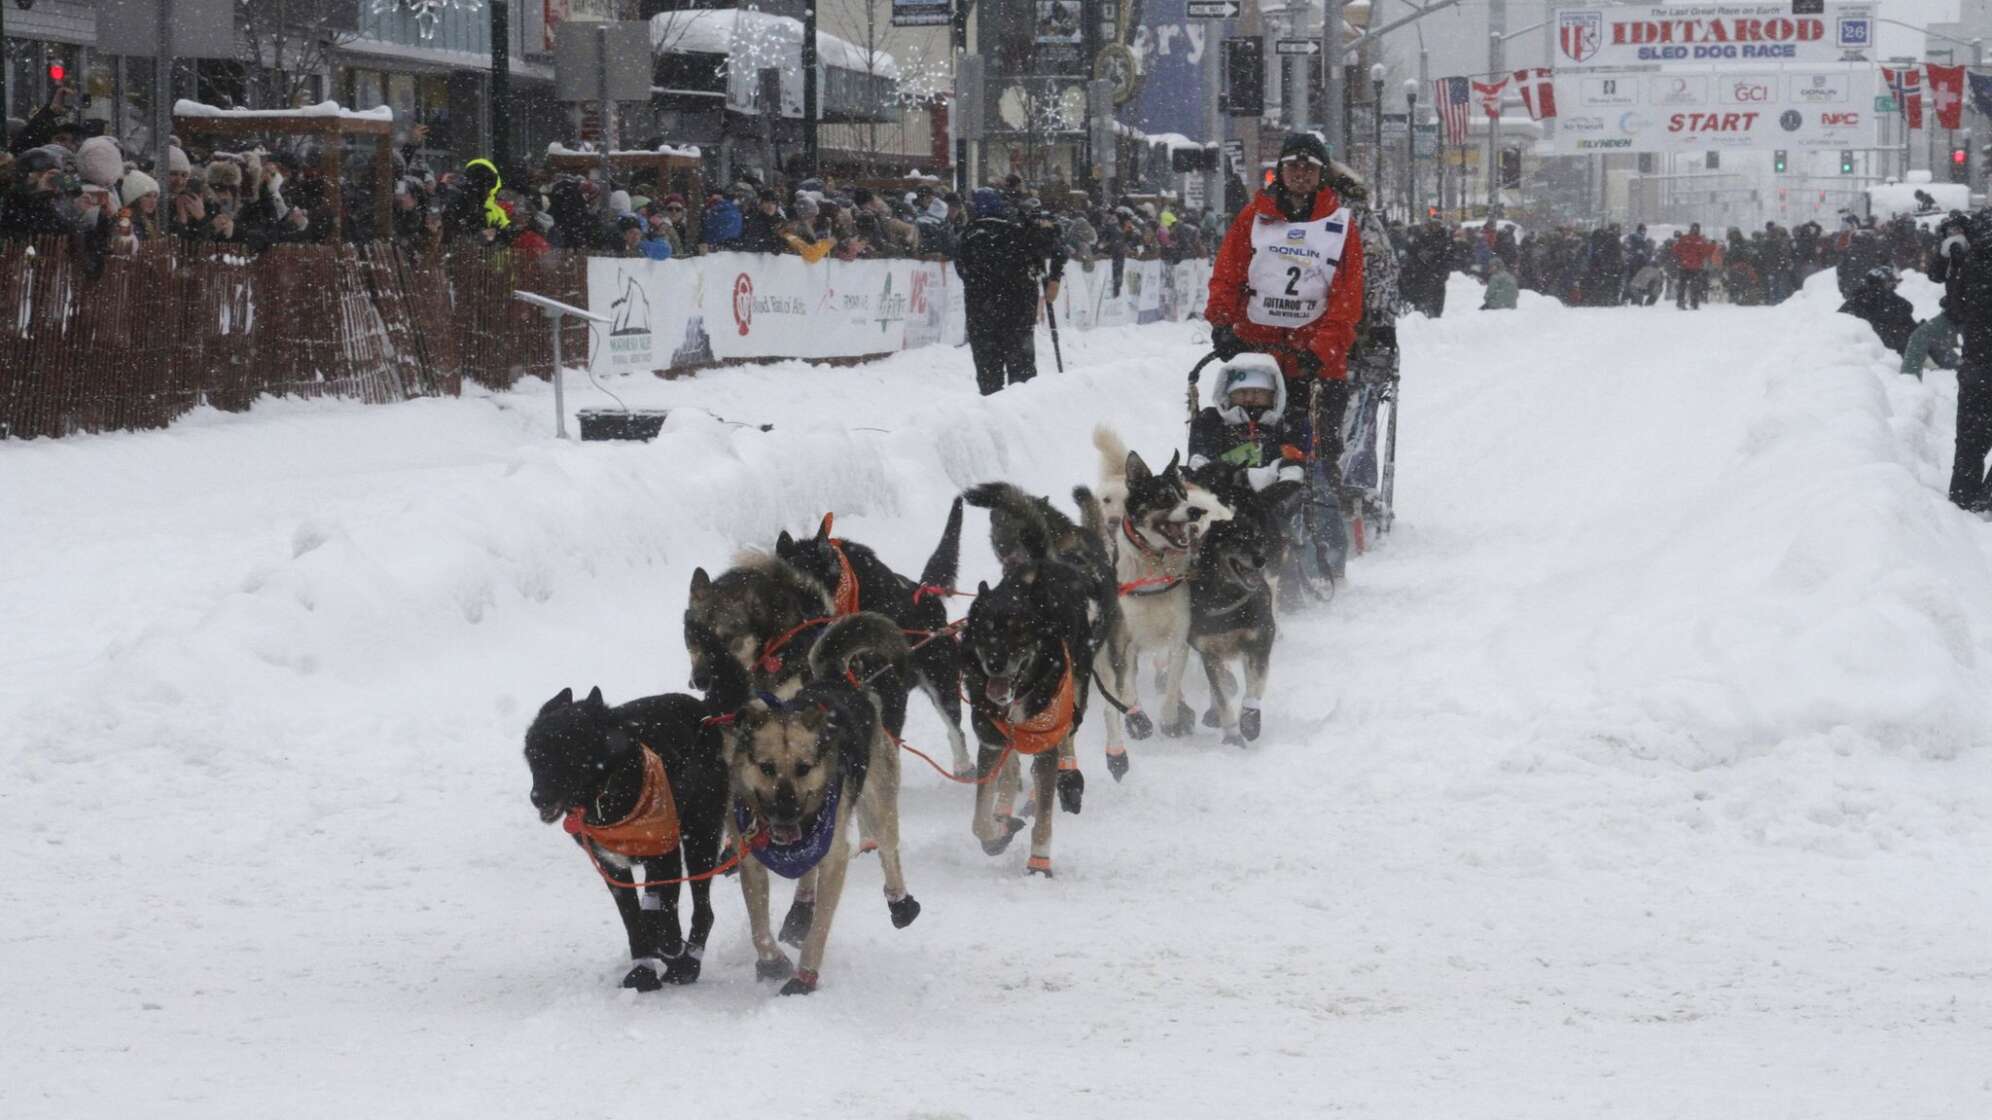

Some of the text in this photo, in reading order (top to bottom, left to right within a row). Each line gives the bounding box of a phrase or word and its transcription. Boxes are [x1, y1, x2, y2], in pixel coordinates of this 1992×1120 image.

[1651, 7, 1668, 16] The
[1669, 7, 1688, 16] Last
[1690, 7, 1715, 16] Great
[1718, 6, 1740, 15] Race
[1756, 6, 1780, 15] Earth
[1610, 18, 1824, 45] IDITAROD
[1637, 44, 1796, 60] SLED DOG RACE
[1735, 85, 1768, 101] GCI
[1667, 111, 1760, 132] START
[1583, 139, 1632, 149] LYNDEN
[1269, 246, 1320, 258] DONLIN
[1285, 266, 1301, 296] 2
[1263, 297, 1301, 311] IDITAROD
